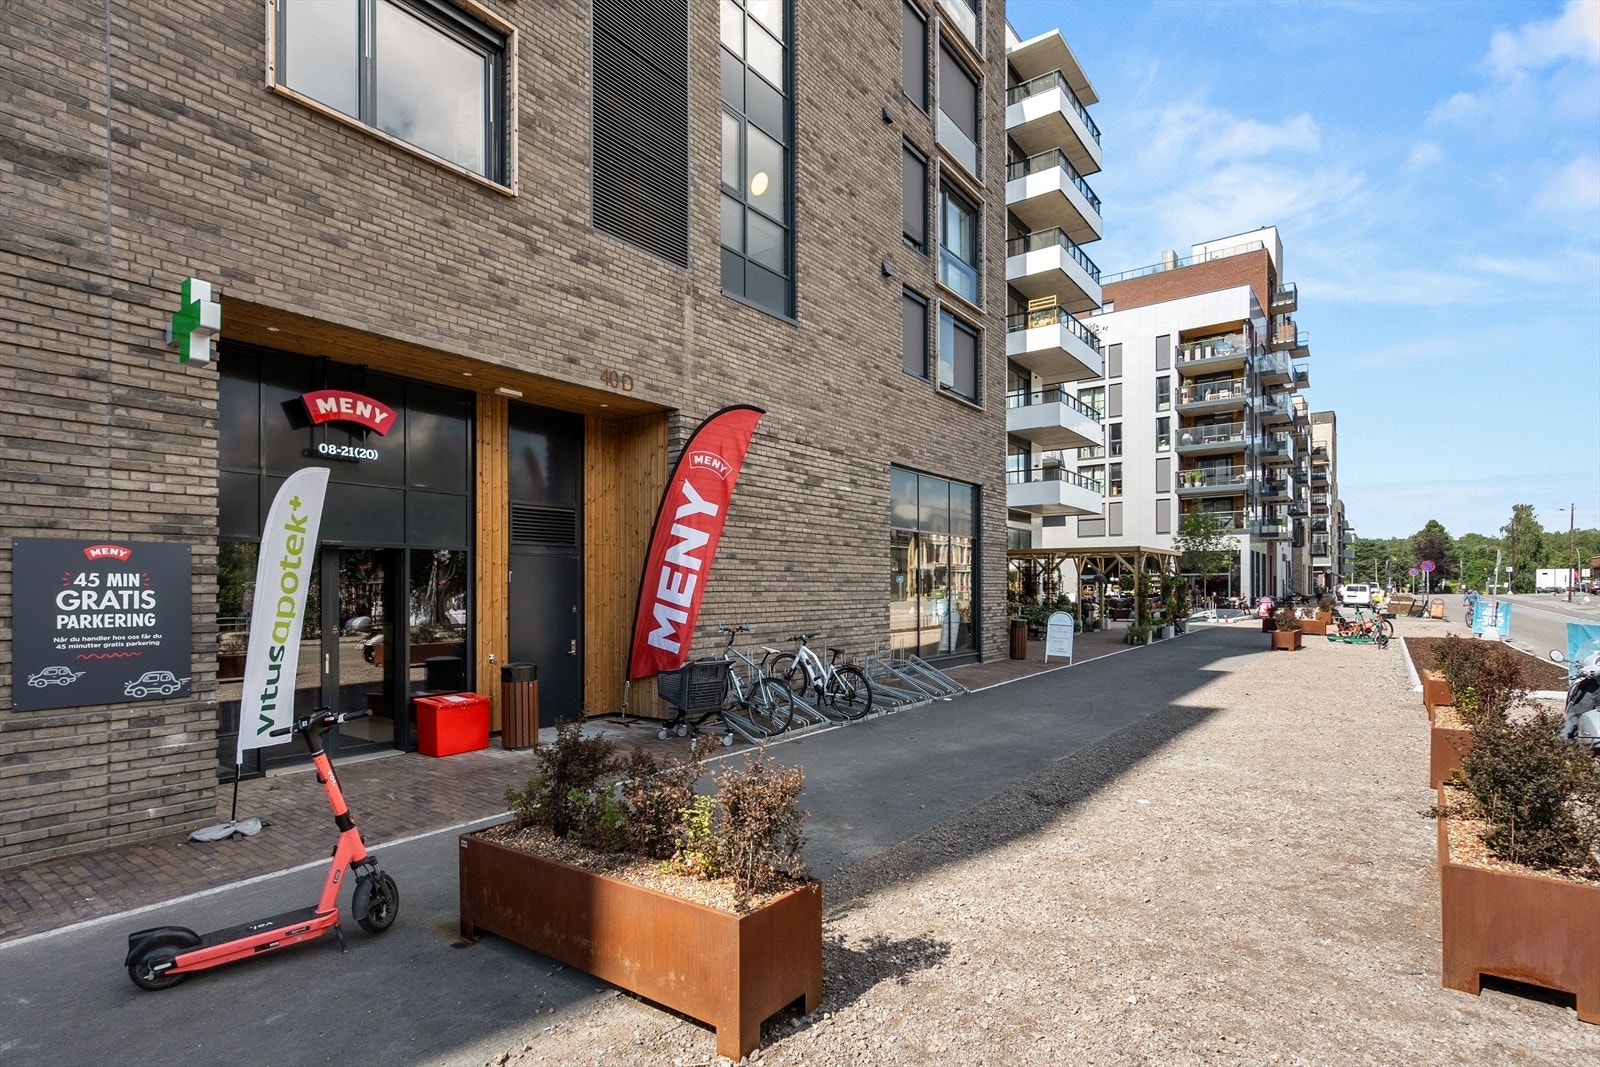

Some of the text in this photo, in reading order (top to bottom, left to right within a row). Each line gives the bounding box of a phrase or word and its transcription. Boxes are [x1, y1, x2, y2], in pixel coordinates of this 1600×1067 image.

[315, 397, 389, 424] MENY
[318, 443, 379, 461] 08-21(20)
[694, 455, 727, 472] MENY
[90, 547, 128, 557] MENY
[647, 478, 719, 654] MENY
[73, 572, 140, 588] 45 MIN
[55, 590, 156, 611] GRATIS
[56, 613, 156, 630] PARKERING
[103, 641, 125, 649] gratis
[125, 640, 160, 648] parkering
